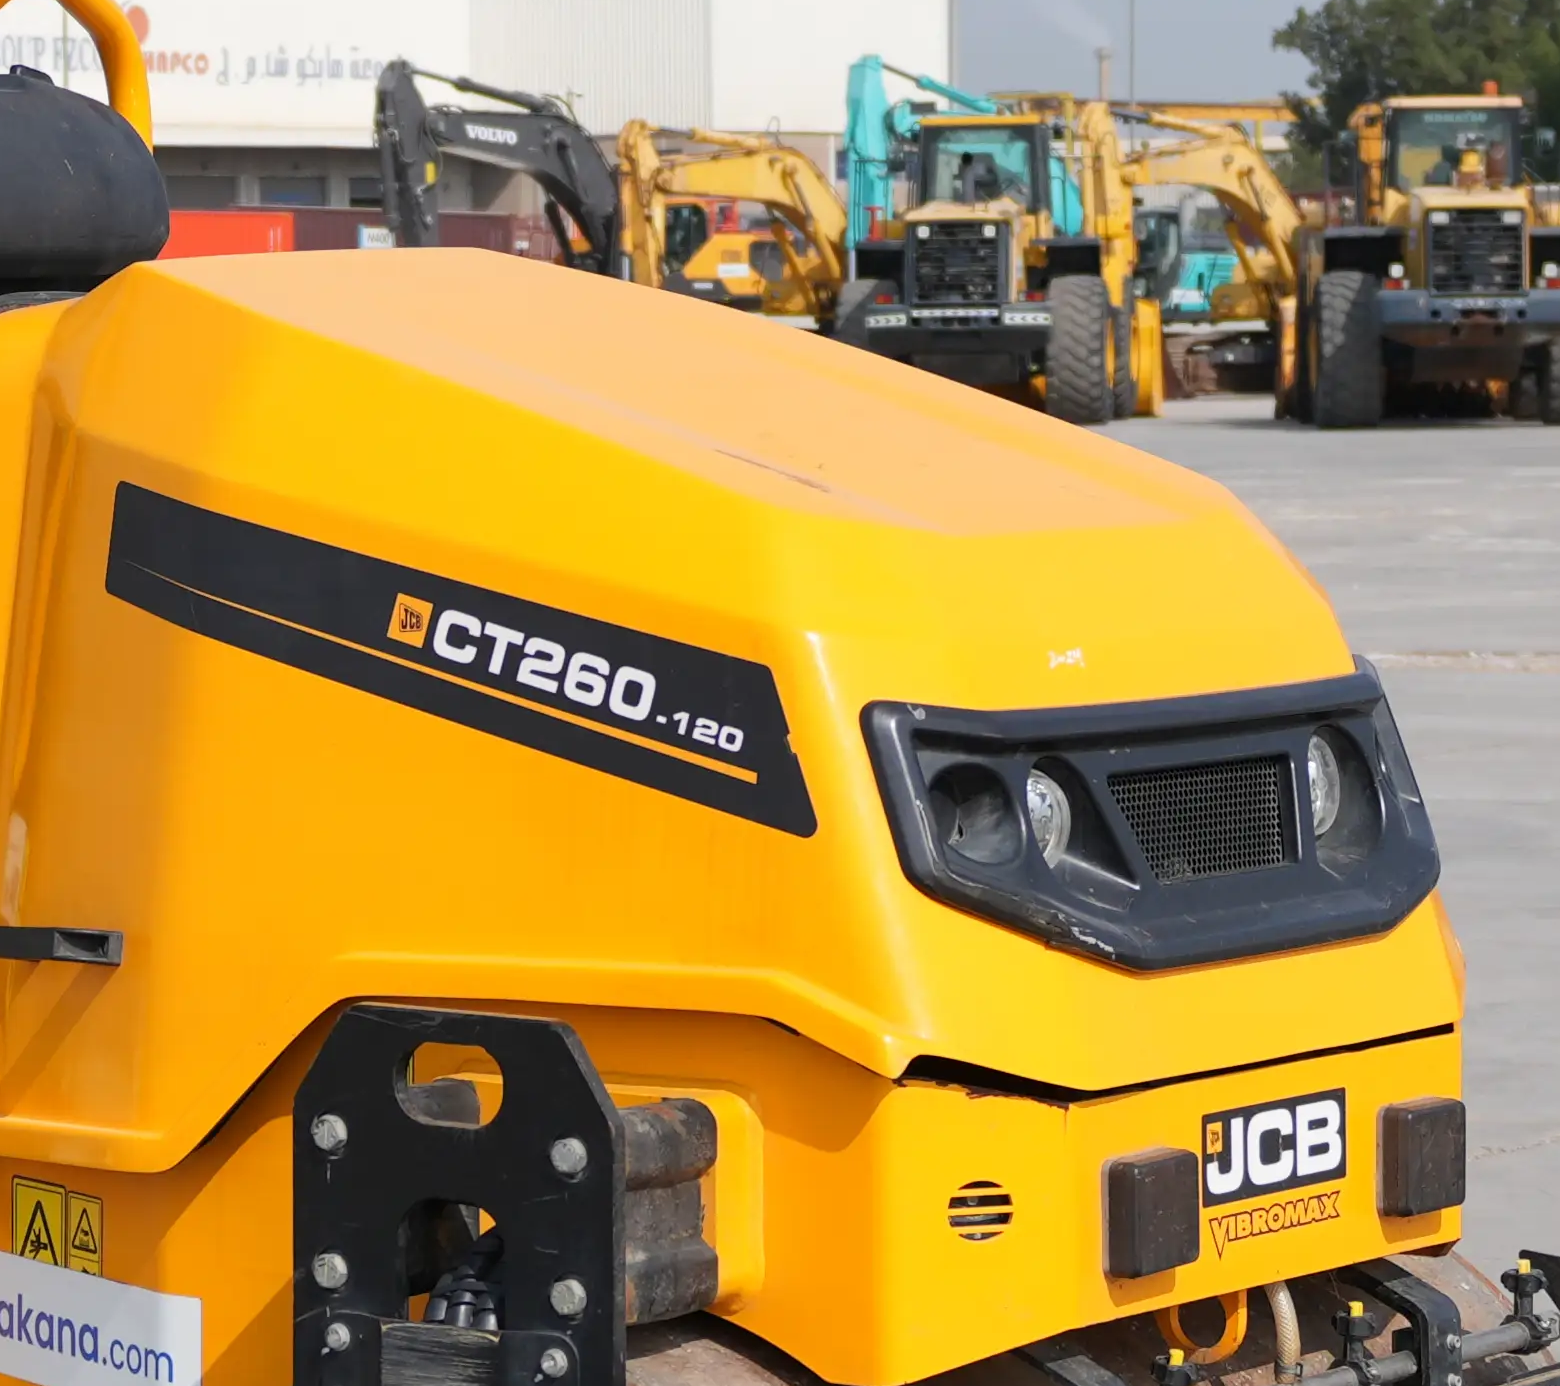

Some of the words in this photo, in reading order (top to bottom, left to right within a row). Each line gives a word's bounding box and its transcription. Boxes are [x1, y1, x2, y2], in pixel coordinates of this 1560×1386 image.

[465, 124, 518, 146] VOLVO
[1206, 1099, 1342, 1195] JCB
[1208, 1190, 1341, 1261] VIBROMAX
